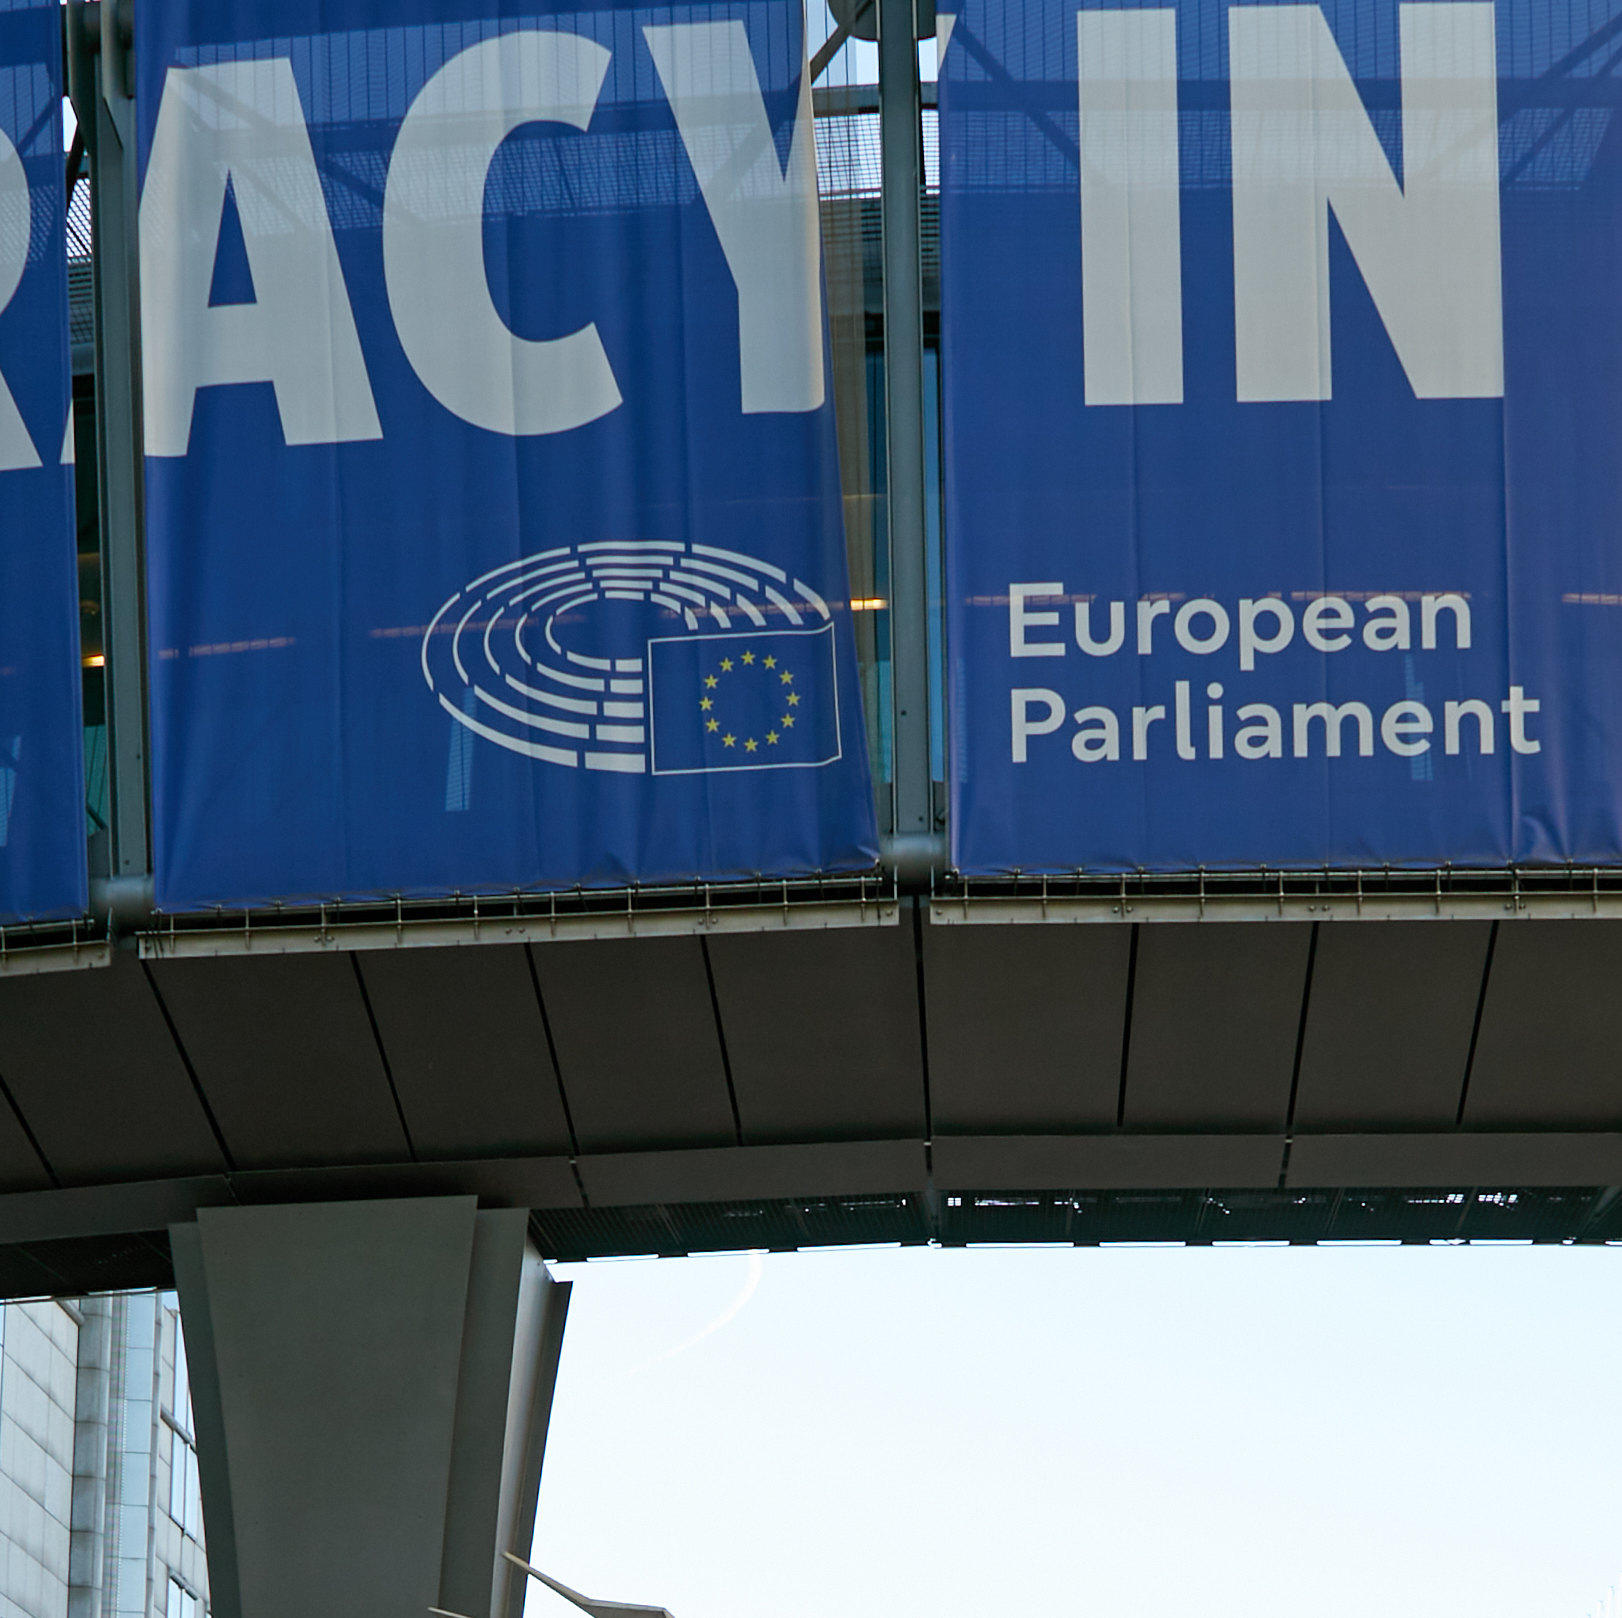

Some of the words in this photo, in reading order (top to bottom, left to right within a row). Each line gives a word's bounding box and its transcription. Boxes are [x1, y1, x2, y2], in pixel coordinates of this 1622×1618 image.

[1075, 0, 1505, 406] IN
[1009, 582, 1473, 669] European
[1010, 682, 1542, 763] Parliament
